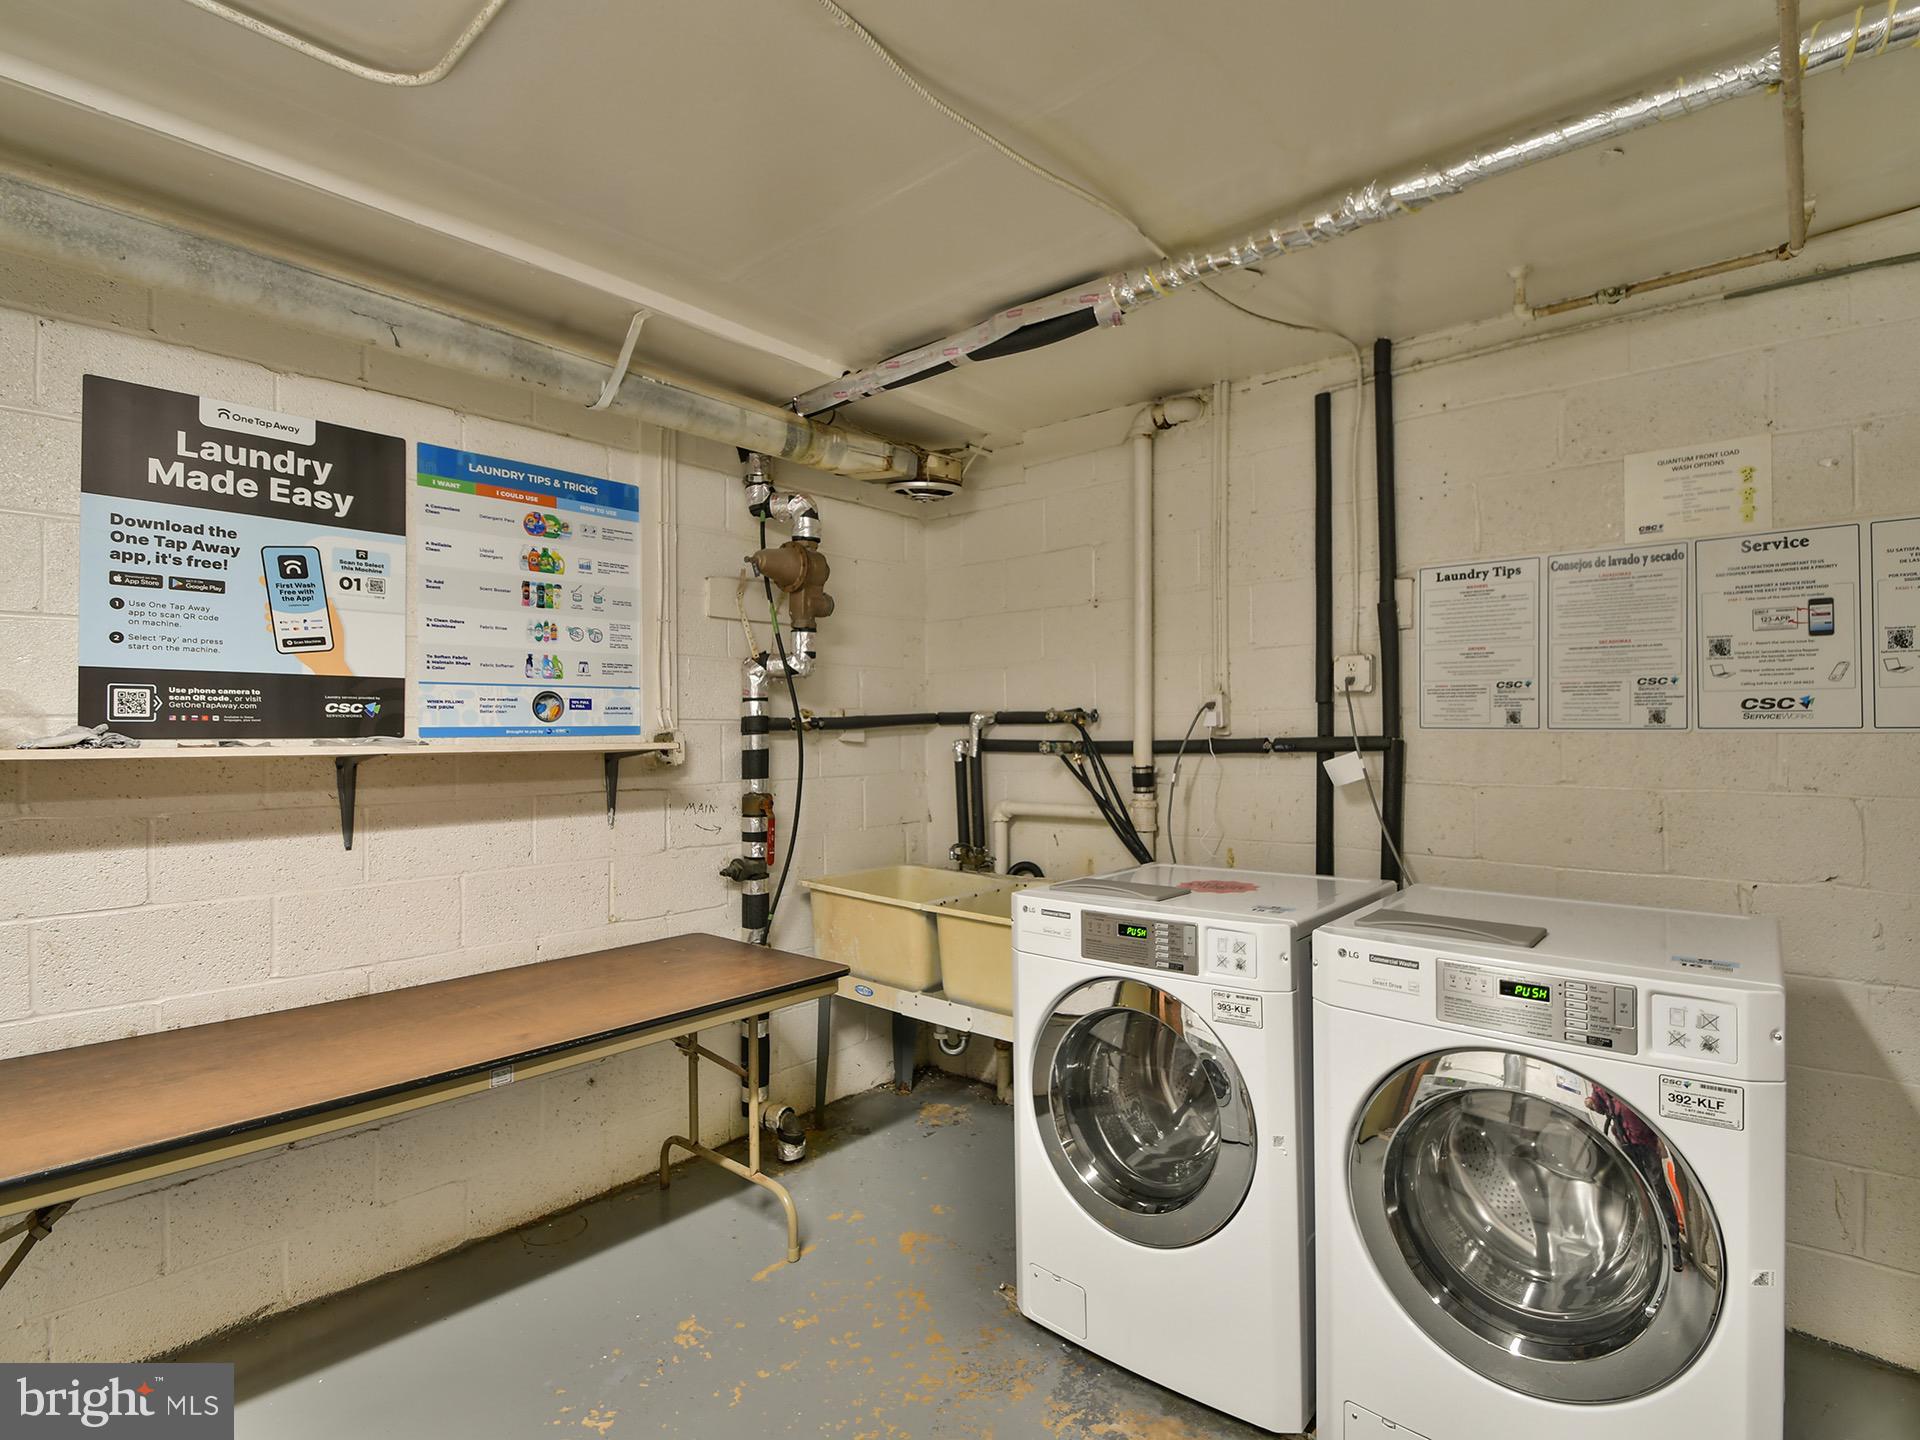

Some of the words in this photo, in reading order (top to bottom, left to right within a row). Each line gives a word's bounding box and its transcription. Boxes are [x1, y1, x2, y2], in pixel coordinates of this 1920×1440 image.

[177, 431, 333, 485] Laundry
[1657, 456, 1694, 466] QUANTUM
[1695, 453, 1718, 461] FRONT
[1720, 449, 1739, 458] LOAD
[1672, 464, 1692, 472] WASH
[1694, 460, 1724, 469] OPTIONS
[437, 480, 461, 490] WANT
[468, 463, 525, 481] LAUNDRY
[528, 474, 551, 487] TIPS
[554, 479, 561, 488] &
[563, 480, 598, 496] TRICKS
[148, 458, 258, 498] Made
[269, 477, 354, 518] Easy
[500, 491, 524, 500] COULD
[525, 495, 538, 503] USE
[110, 512, 205, 535] Download
[208, 526, 238, 539] the
[110, 530, 149, 546] One
[154, 535, 188, 552] Tap
[192, 540, 241, 558] Away
[1741, 536, 1810, 553] Service
[110, 550, 151, 566] app,
[155, 552, 183, 566] it's
[187, 556, 228, 571] free!
[1551, 560, 1592, 573] Consejos
[1594, 557, 1606, 568] de
[1608, 554, 1640, 567] lavado
[1642, 556, 1649, 567] y
[1650, 549, 1685, 563] secado
[355, 566, 383, 574] Machine
[1436, 568, 1489, 583] Laundry
[1492, 566, 1521, 579] Tips
[124, 578, 139, 586] App
[140, 579, 160, 587] Store
[186, 583, 209, 592] Google
[209, 585, 223, 593] Play
[128, 600, 146, 608] Use
[170, 603, 186, 611] Tap
[188, 604, 210, 613] Away
[128, 610, 145, 618] app
[184, 613, 196, 621] QR
[198, 614, 219, 622] code
[142, 620, 182, 628] machine.
[128, 634, 156, 642] Select
[182, 636, 198, 644] and
[200, 638, 224, 646] press
[182, 646, 221, 654] machine.
[1496, 681, 1522, 689] CSC
[1637, 678, 1668, 686] CSC
[168, 687, 187, 695] Use
[188, 687, 215, 696] phone
[249, 688, 261, 696] to
[192, 694, 206, 702] QR
[1741, 698, 1796, 710] CSC
[168, 702, 257, 711] GetOneTapAway.com
[325, 703, 363, 713] CSC
[684, 802, 718, 815] MAIN
[1126, 927, 1147, 937] PUSH
[1370, 955, 1398, 966] Commercial
[1399, 960, 1418, 969] Washer
[1514, 985, 1548, 999] PUSH
[1217, 1002, 1251, 1014] 393-KLF
[1662, 1078, 1682, 1086] CSC
[1668, 1092, 1725, 1110] 392-KLF
